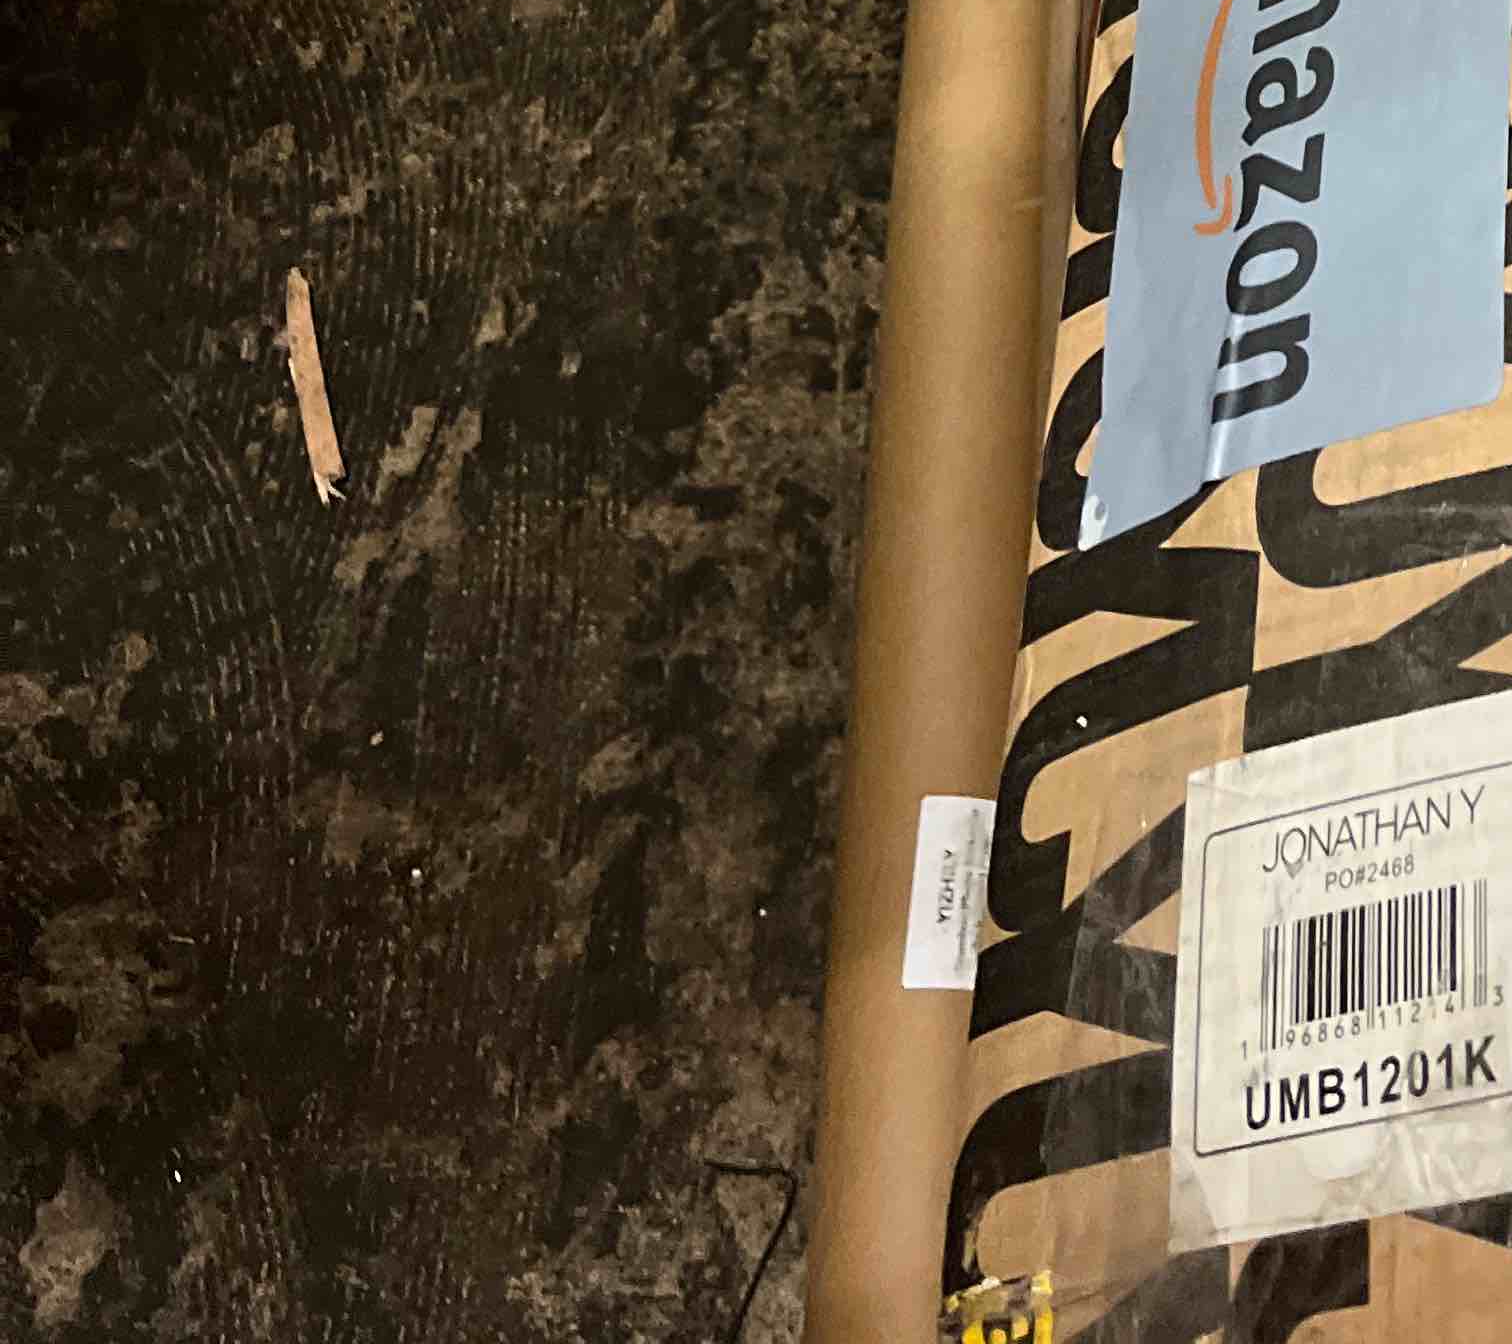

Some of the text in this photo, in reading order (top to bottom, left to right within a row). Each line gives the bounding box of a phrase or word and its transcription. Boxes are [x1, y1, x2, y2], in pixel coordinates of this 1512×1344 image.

[1262, 786, 1485, 874] JONATHAN Y
[1325, 854, 1416, 891] PO#2468
[1241, 1041, 1249, 1061] 1
[1492, 985, 1505, 1006] 3
[1245, 1037, 1497, 1130] UMB1201K
